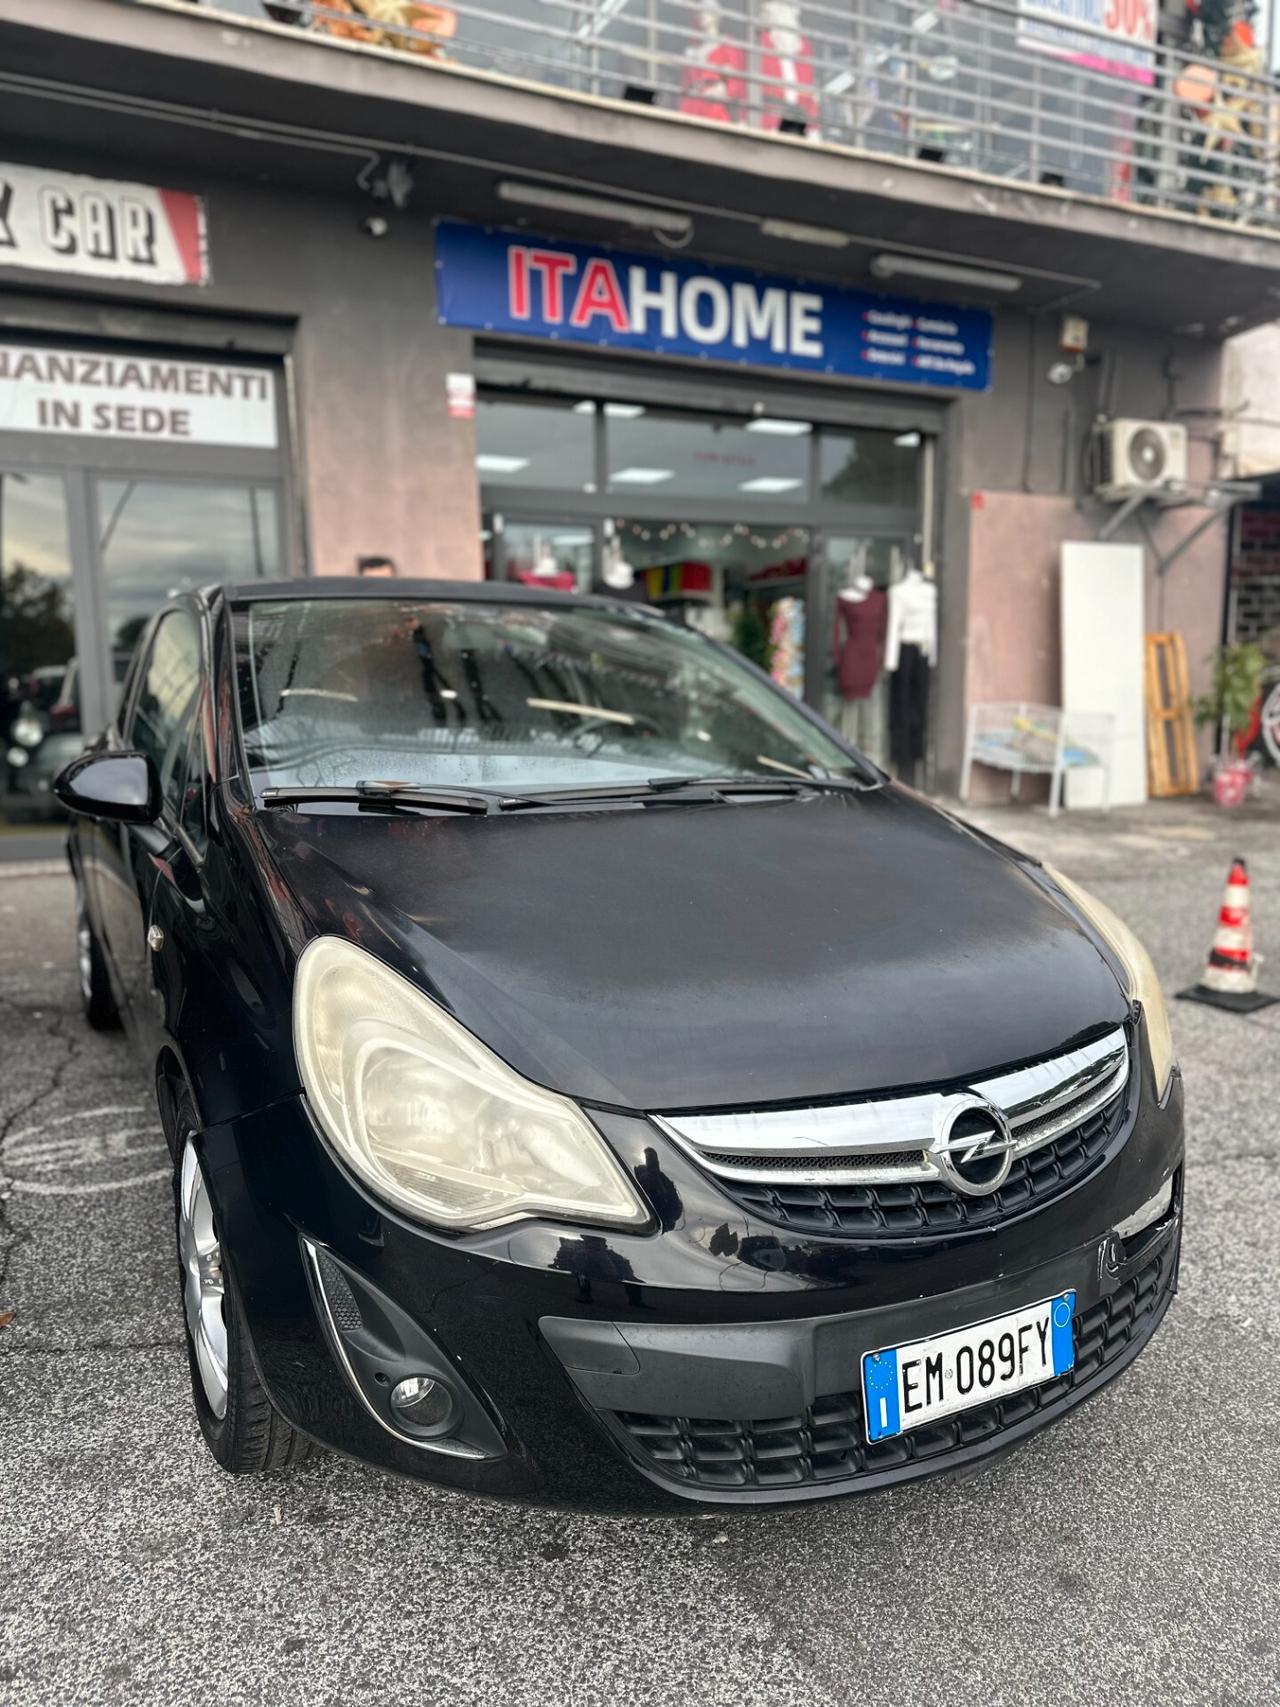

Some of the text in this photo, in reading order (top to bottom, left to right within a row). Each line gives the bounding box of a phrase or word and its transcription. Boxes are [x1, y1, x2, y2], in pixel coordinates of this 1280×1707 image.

[38, 184, 158, 266] CAR
[508, 245, 823, 358] ITAHOME
[37, 398, 191, 436] IN SEDE
[902, 1317, 1050, 1414] EM 089FY
